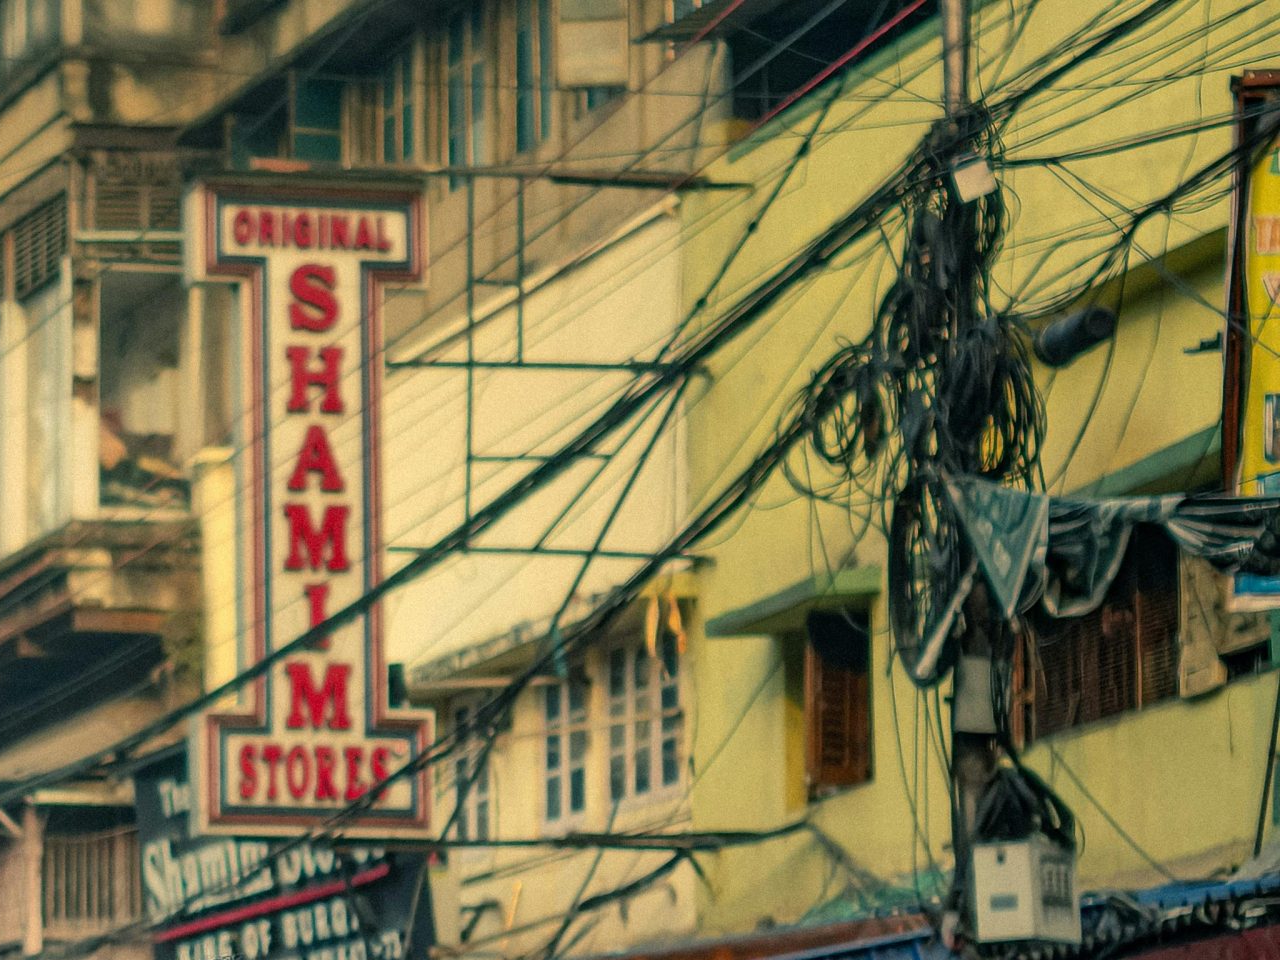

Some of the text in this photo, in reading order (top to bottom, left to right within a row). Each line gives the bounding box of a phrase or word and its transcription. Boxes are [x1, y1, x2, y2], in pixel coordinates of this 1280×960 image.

[234, 210, 393, 253] ORIGINAL
[283, 263, 352, 731] SHAMIM
[239, 743, 389, 802] STORES
